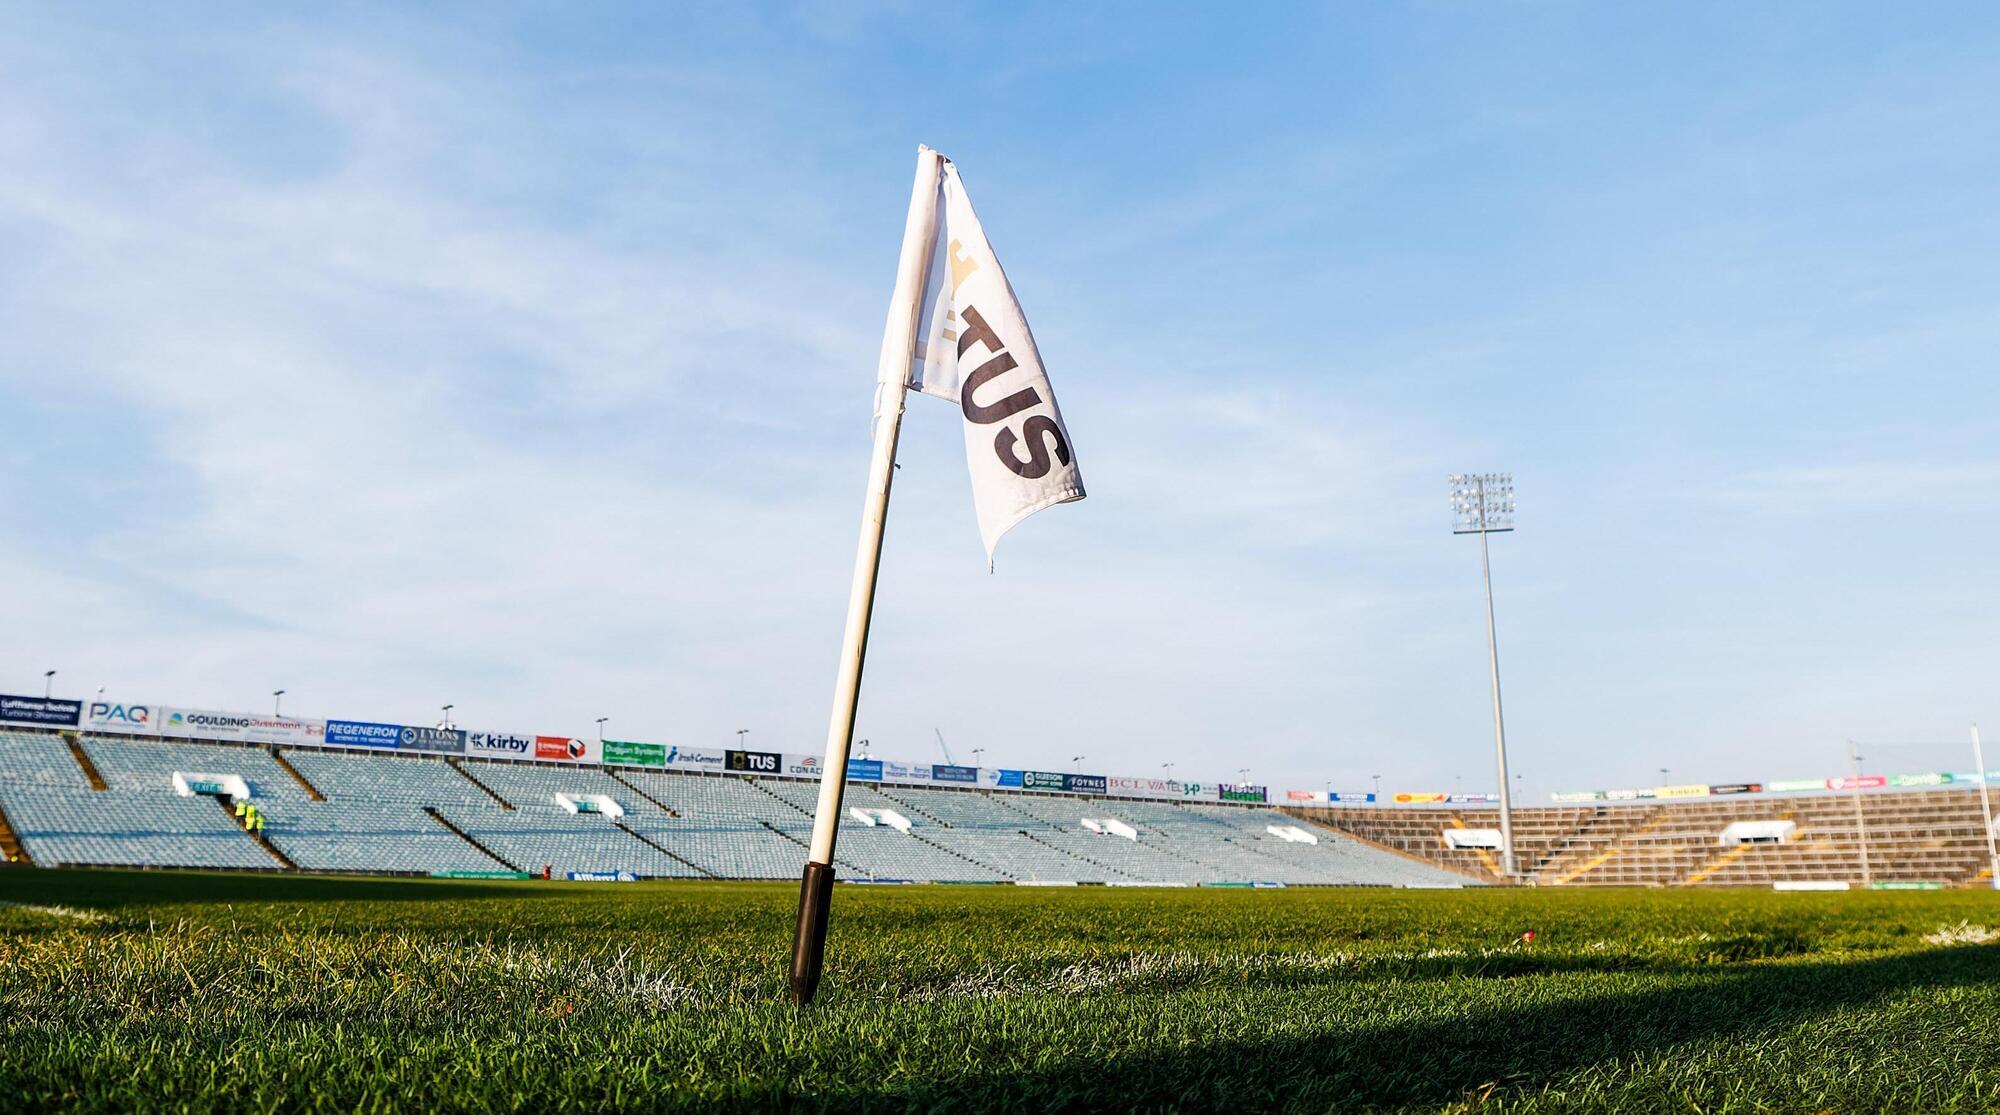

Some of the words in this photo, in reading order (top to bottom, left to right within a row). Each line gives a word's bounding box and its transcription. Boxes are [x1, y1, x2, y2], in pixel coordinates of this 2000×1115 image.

[957, 304, 1070, 480] TUS
[186, 714, 249, 728] GOULDING
[250, 719, 301, 729] Dussmann
[327, 723, 399, 738] REGENERON
[419, 730, 459, 741] LYONS
[486, 734, 529, 753] kirby
[605, 744, 633, 756] Duggan
[634, 746, 664, 757] Systems
[678, 752, 695, 762] Irish
[695, 753, 723, 764] Cement
[747, 754, 775, 770] TUS
[1035, 773, 1063, 781] GLEESON
[1072, 778, 1105, 788] FOYNES
